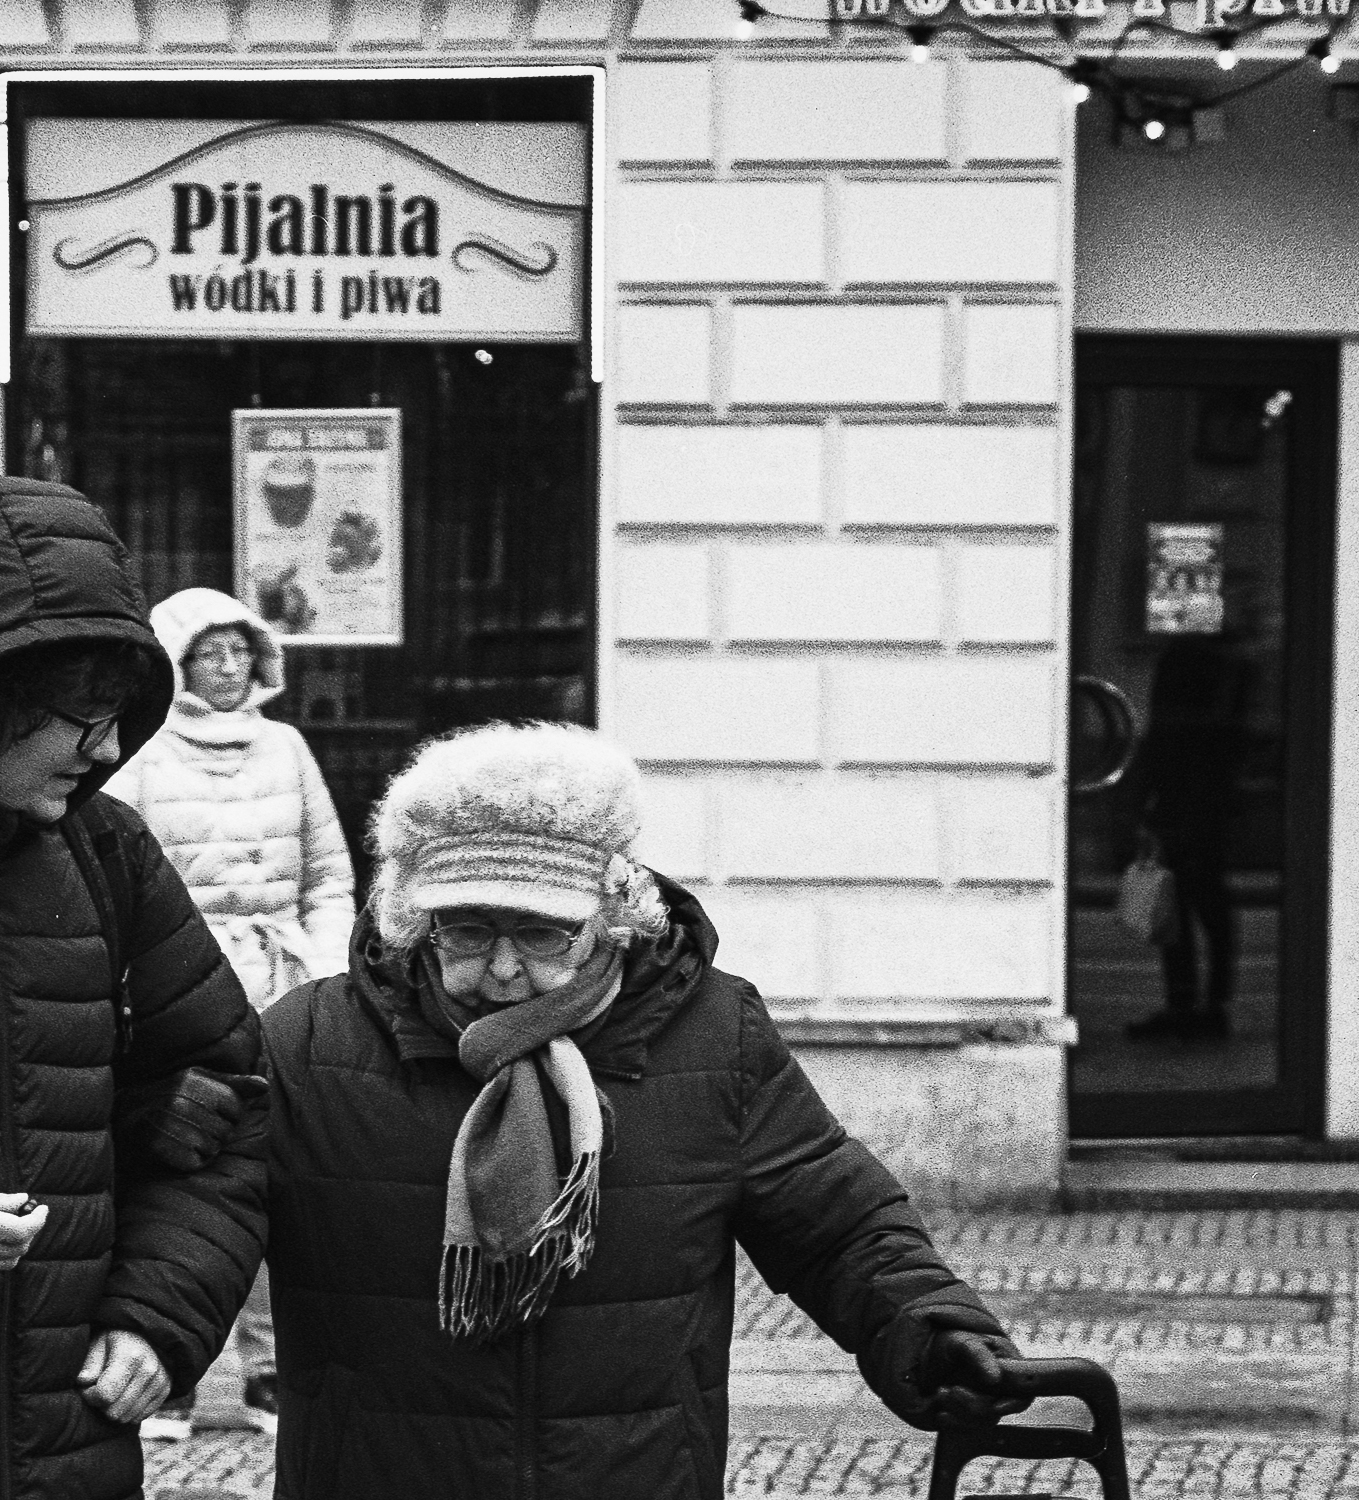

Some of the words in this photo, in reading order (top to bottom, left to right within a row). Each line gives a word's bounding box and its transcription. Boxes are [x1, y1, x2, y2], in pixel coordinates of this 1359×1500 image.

[170, 181, 441, 265] Pijalnia
[169, 264, 297, 313] wódki
[311, 268, 326, 314] i
[340, 268, 442, 321] piwa
